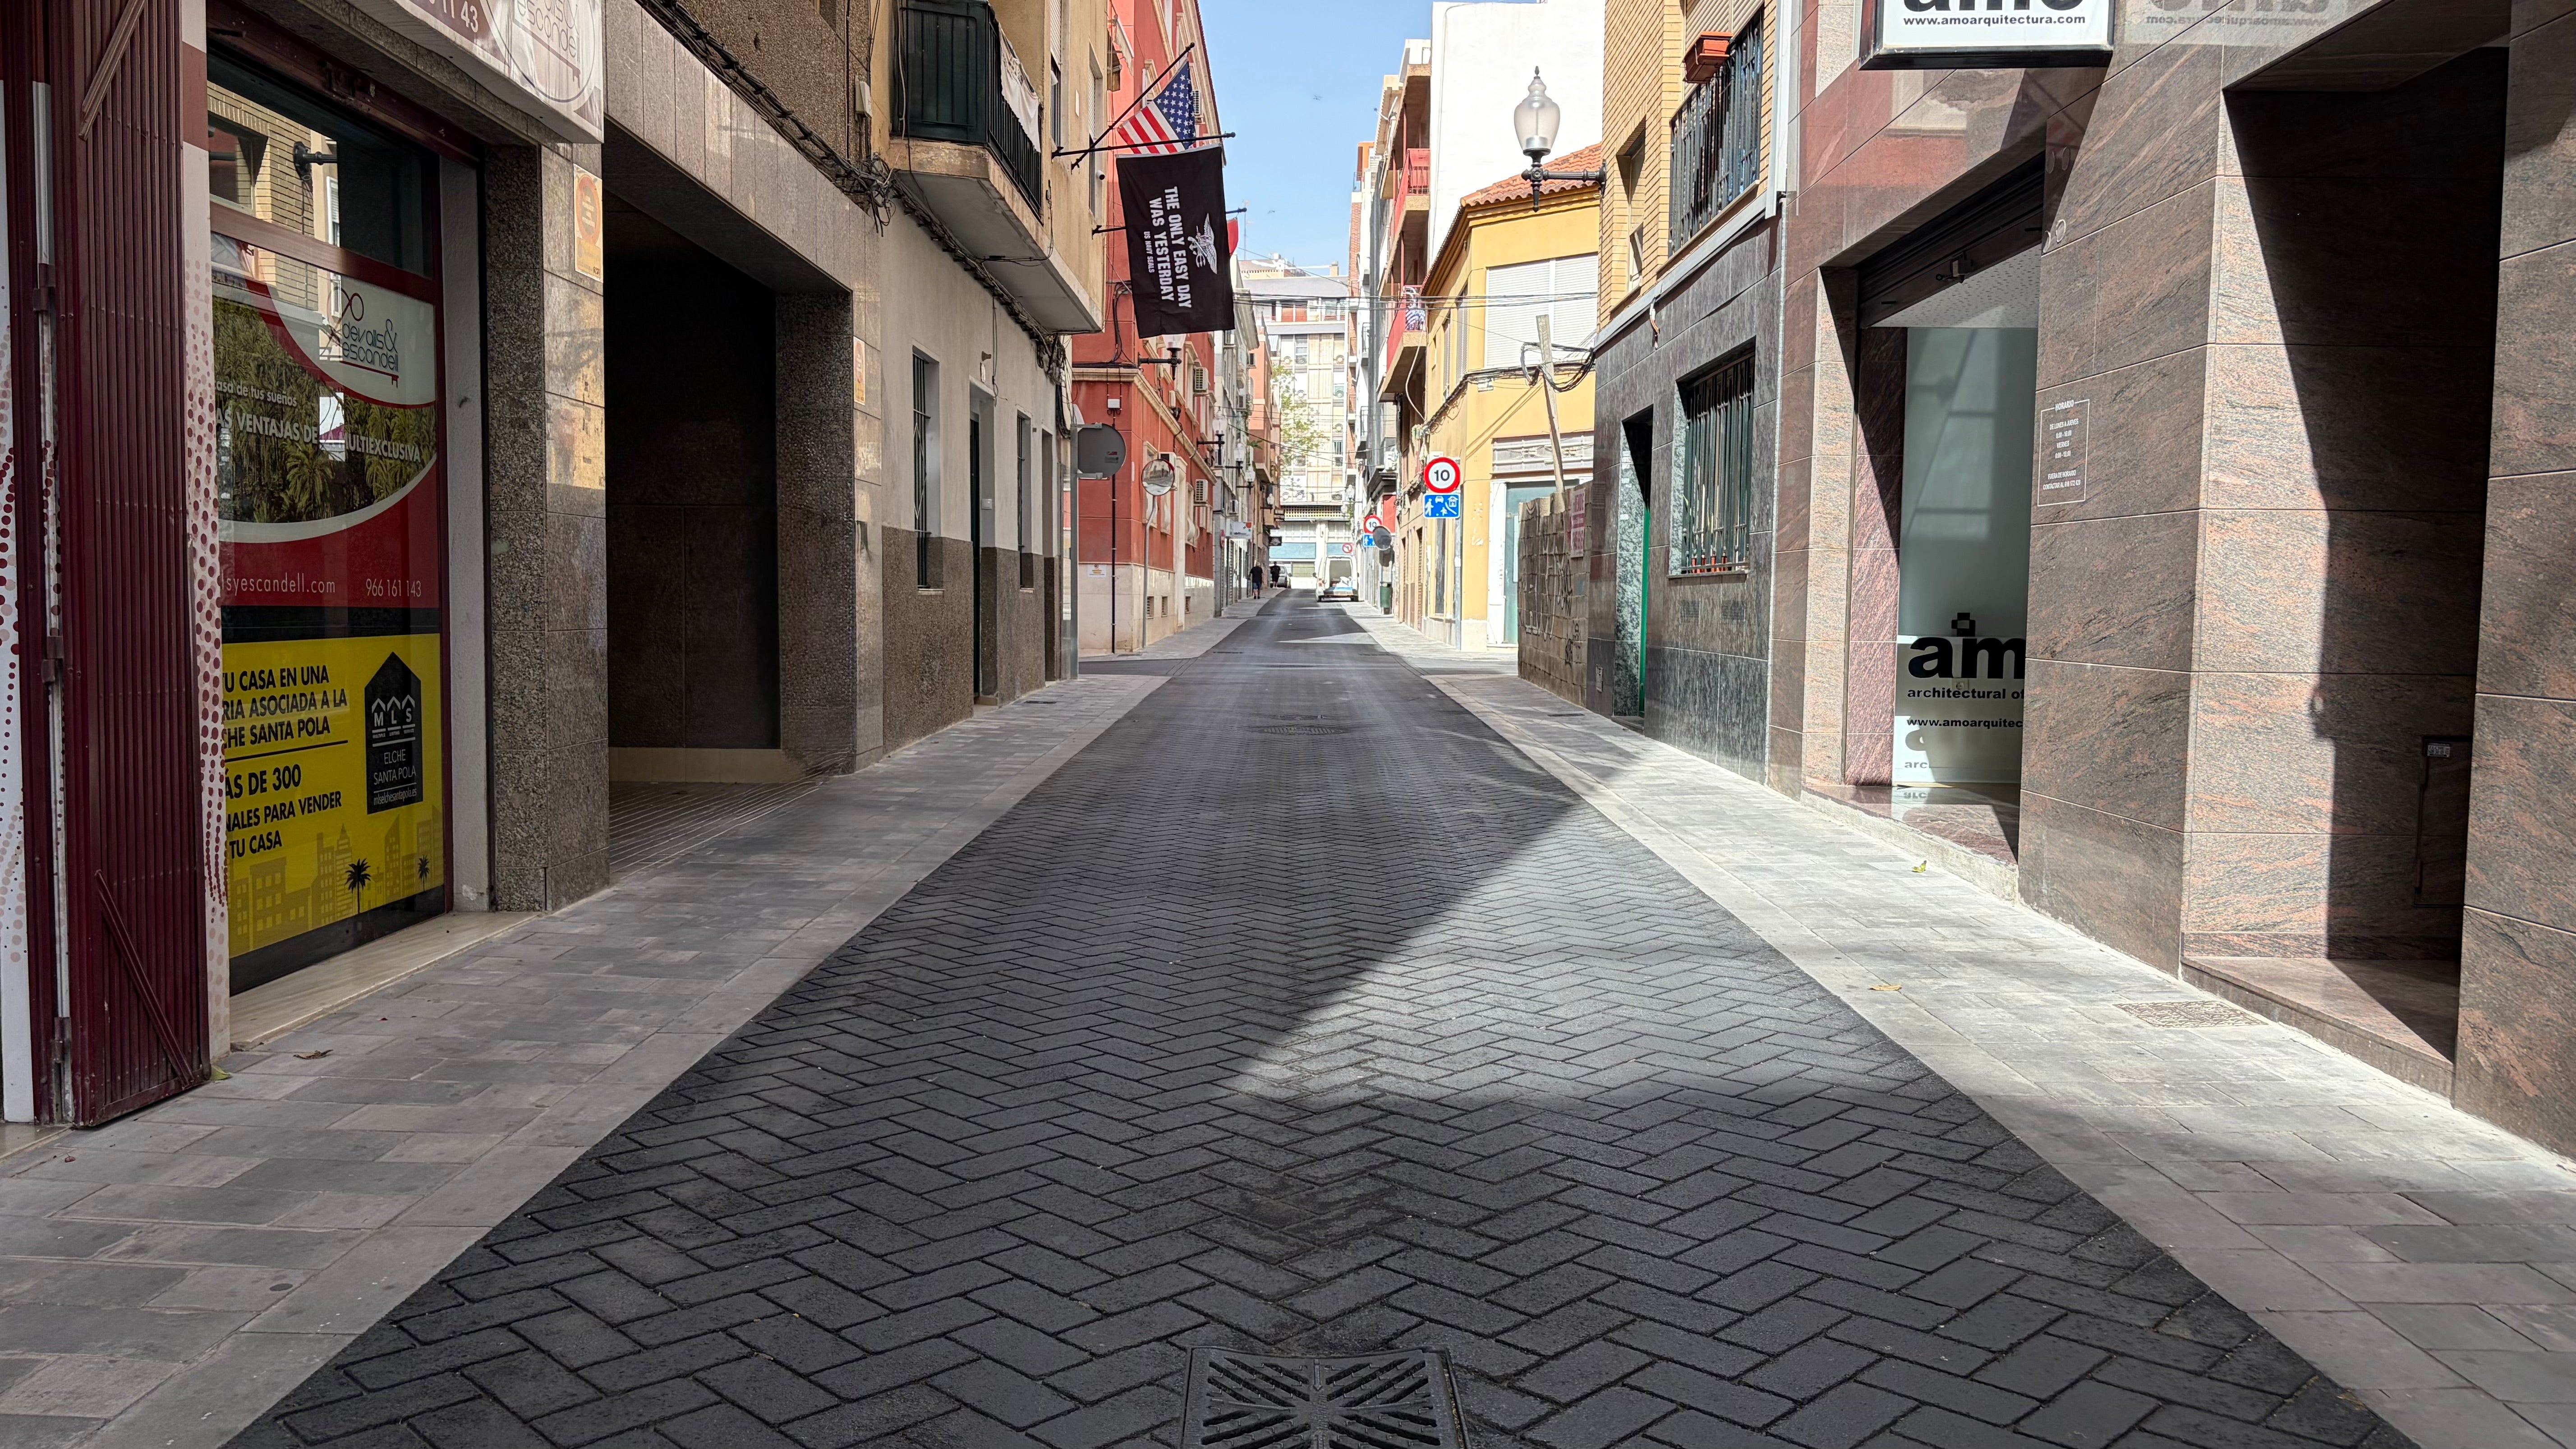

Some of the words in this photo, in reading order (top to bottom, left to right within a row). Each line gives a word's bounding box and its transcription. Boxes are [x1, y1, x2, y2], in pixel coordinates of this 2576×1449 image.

[460, 0, 478, 32] 43
[1903, 14, 2086, 27] www.amoarquitectura.com
[1164, 186, 1180, 210] THE
[1149, 198, 1165, 226] WAS
[1168, 214, 1185, 245] ONLY
[1145, 240, 1153, 254] NAVY
[1154, 231, 1174, 301] YESTERDAY
[1173, 250, 1189, 280] EASY
[1177, 285, 1192, 308] DAY
[342, 342, 399, 372] escandell
[236, 384, 248, 396] de
[251, 386, 264, 400] tus
[267, 391, 297, 407] sueños
[236, 411, 300, 441] VENTAJAS
[304, 425, 317, 444] DE
[1434, 469, 1450, 482] 10
[366, 578, 384, 597] 966
[387, 579, 401, 597] 161
[406, 580, 421, 597] 143
[239, 669, 276, 691] CASA
[280, 667, 297, 687] EN
[301, 665, 329, 685] UNA
[249, 692, 317, 718] ASOCIADA
[321, 690, 330, 708] A
[333, 689, 347, 707] LA
[1907, 688, 2006, 699] architectural
[250, 721, 294, 745] SANTA
[298, 716, 330, 737] POLA
[1907, 718, 2023, 729] www.amoarquitec
[384, 749, 406, 764] ELCHE
[248, 770, 267, 796] DE
[272, 764, 301, 791] 300
[373, 769, 397, 785] SANTA
[398, 765, 416, 782] POLA
[264, 801, 295, 823] PARA
[298, 791, 342, 815] VENDER
[230, 837, 245, 859] TU
[249, 830, 282, 854] CASA
